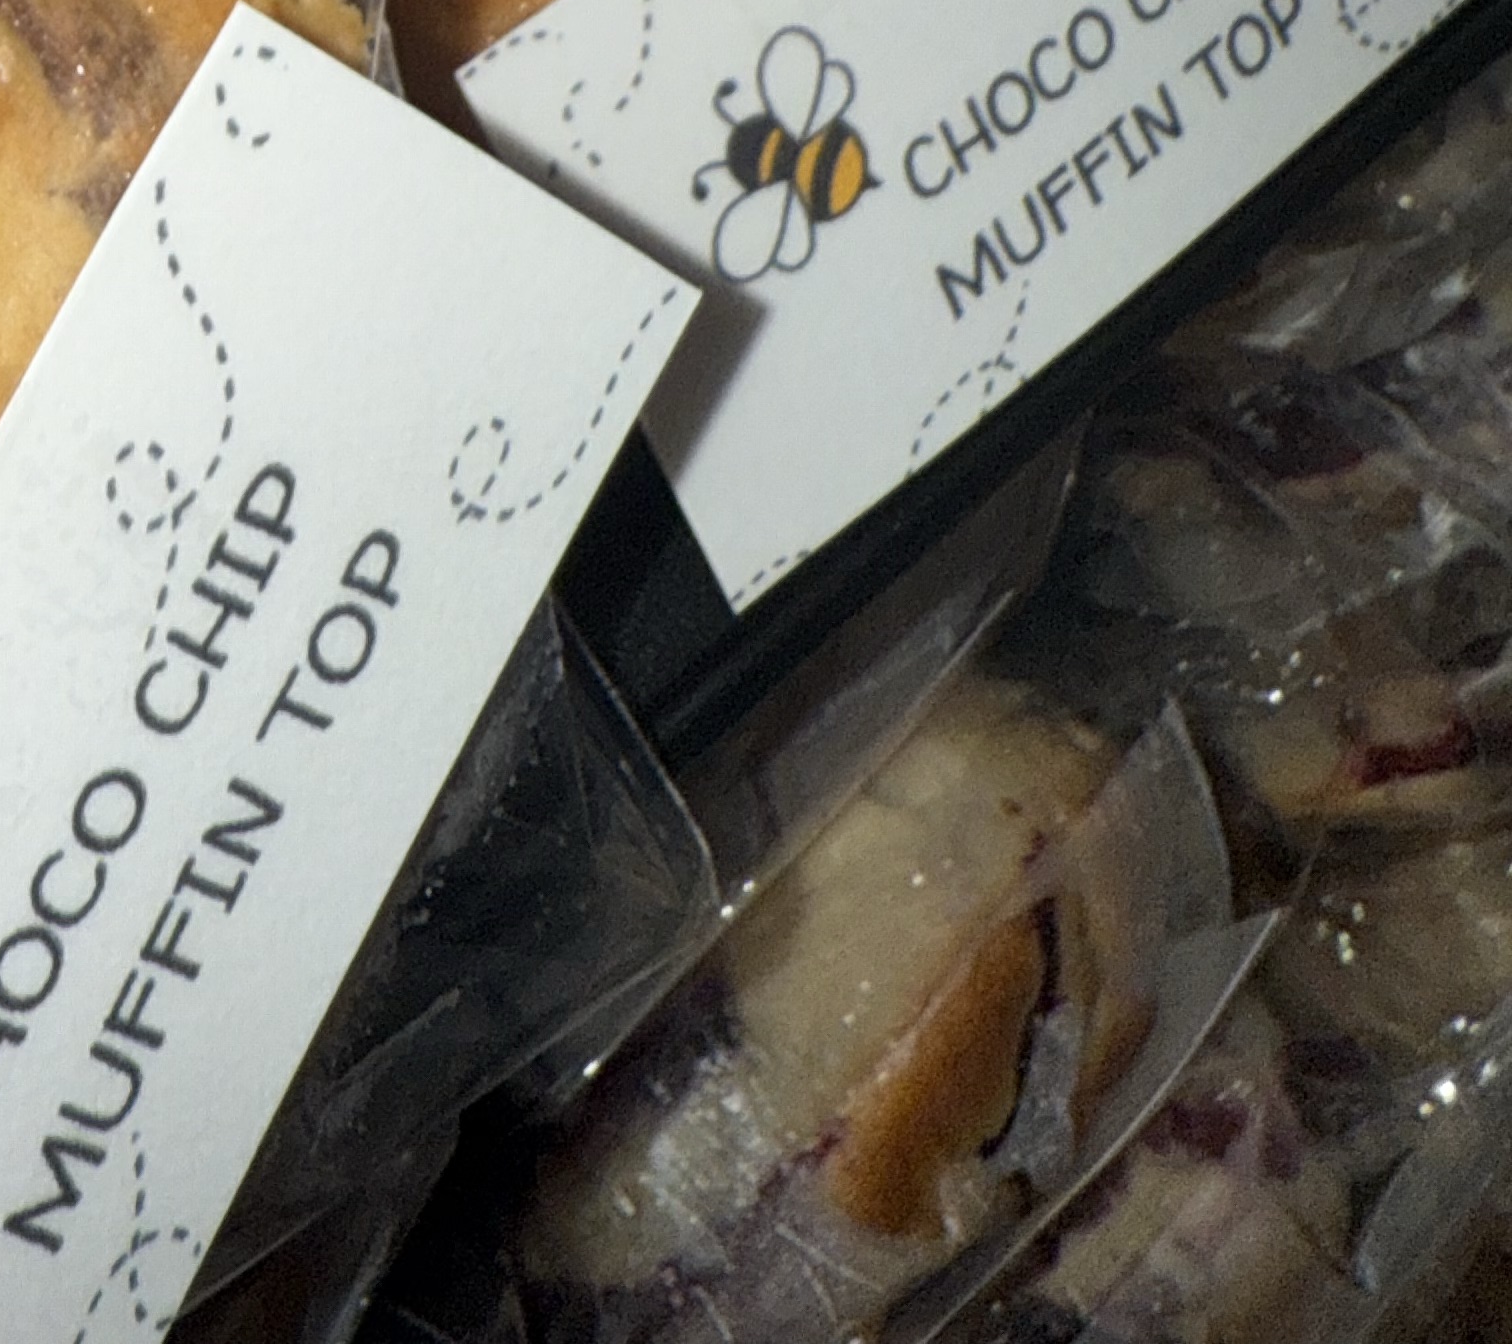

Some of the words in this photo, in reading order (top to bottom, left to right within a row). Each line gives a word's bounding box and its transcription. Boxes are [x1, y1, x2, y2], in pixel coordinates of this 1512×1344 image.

[903, 6, 1115, 199] CHOCO
[934, 82, 1184, 321] MUFFIN
[133, 461, 297, 736] CHIP
[2, 776, 285, 1255] MUFFIN
[255, 528, 402, 743] TOP
